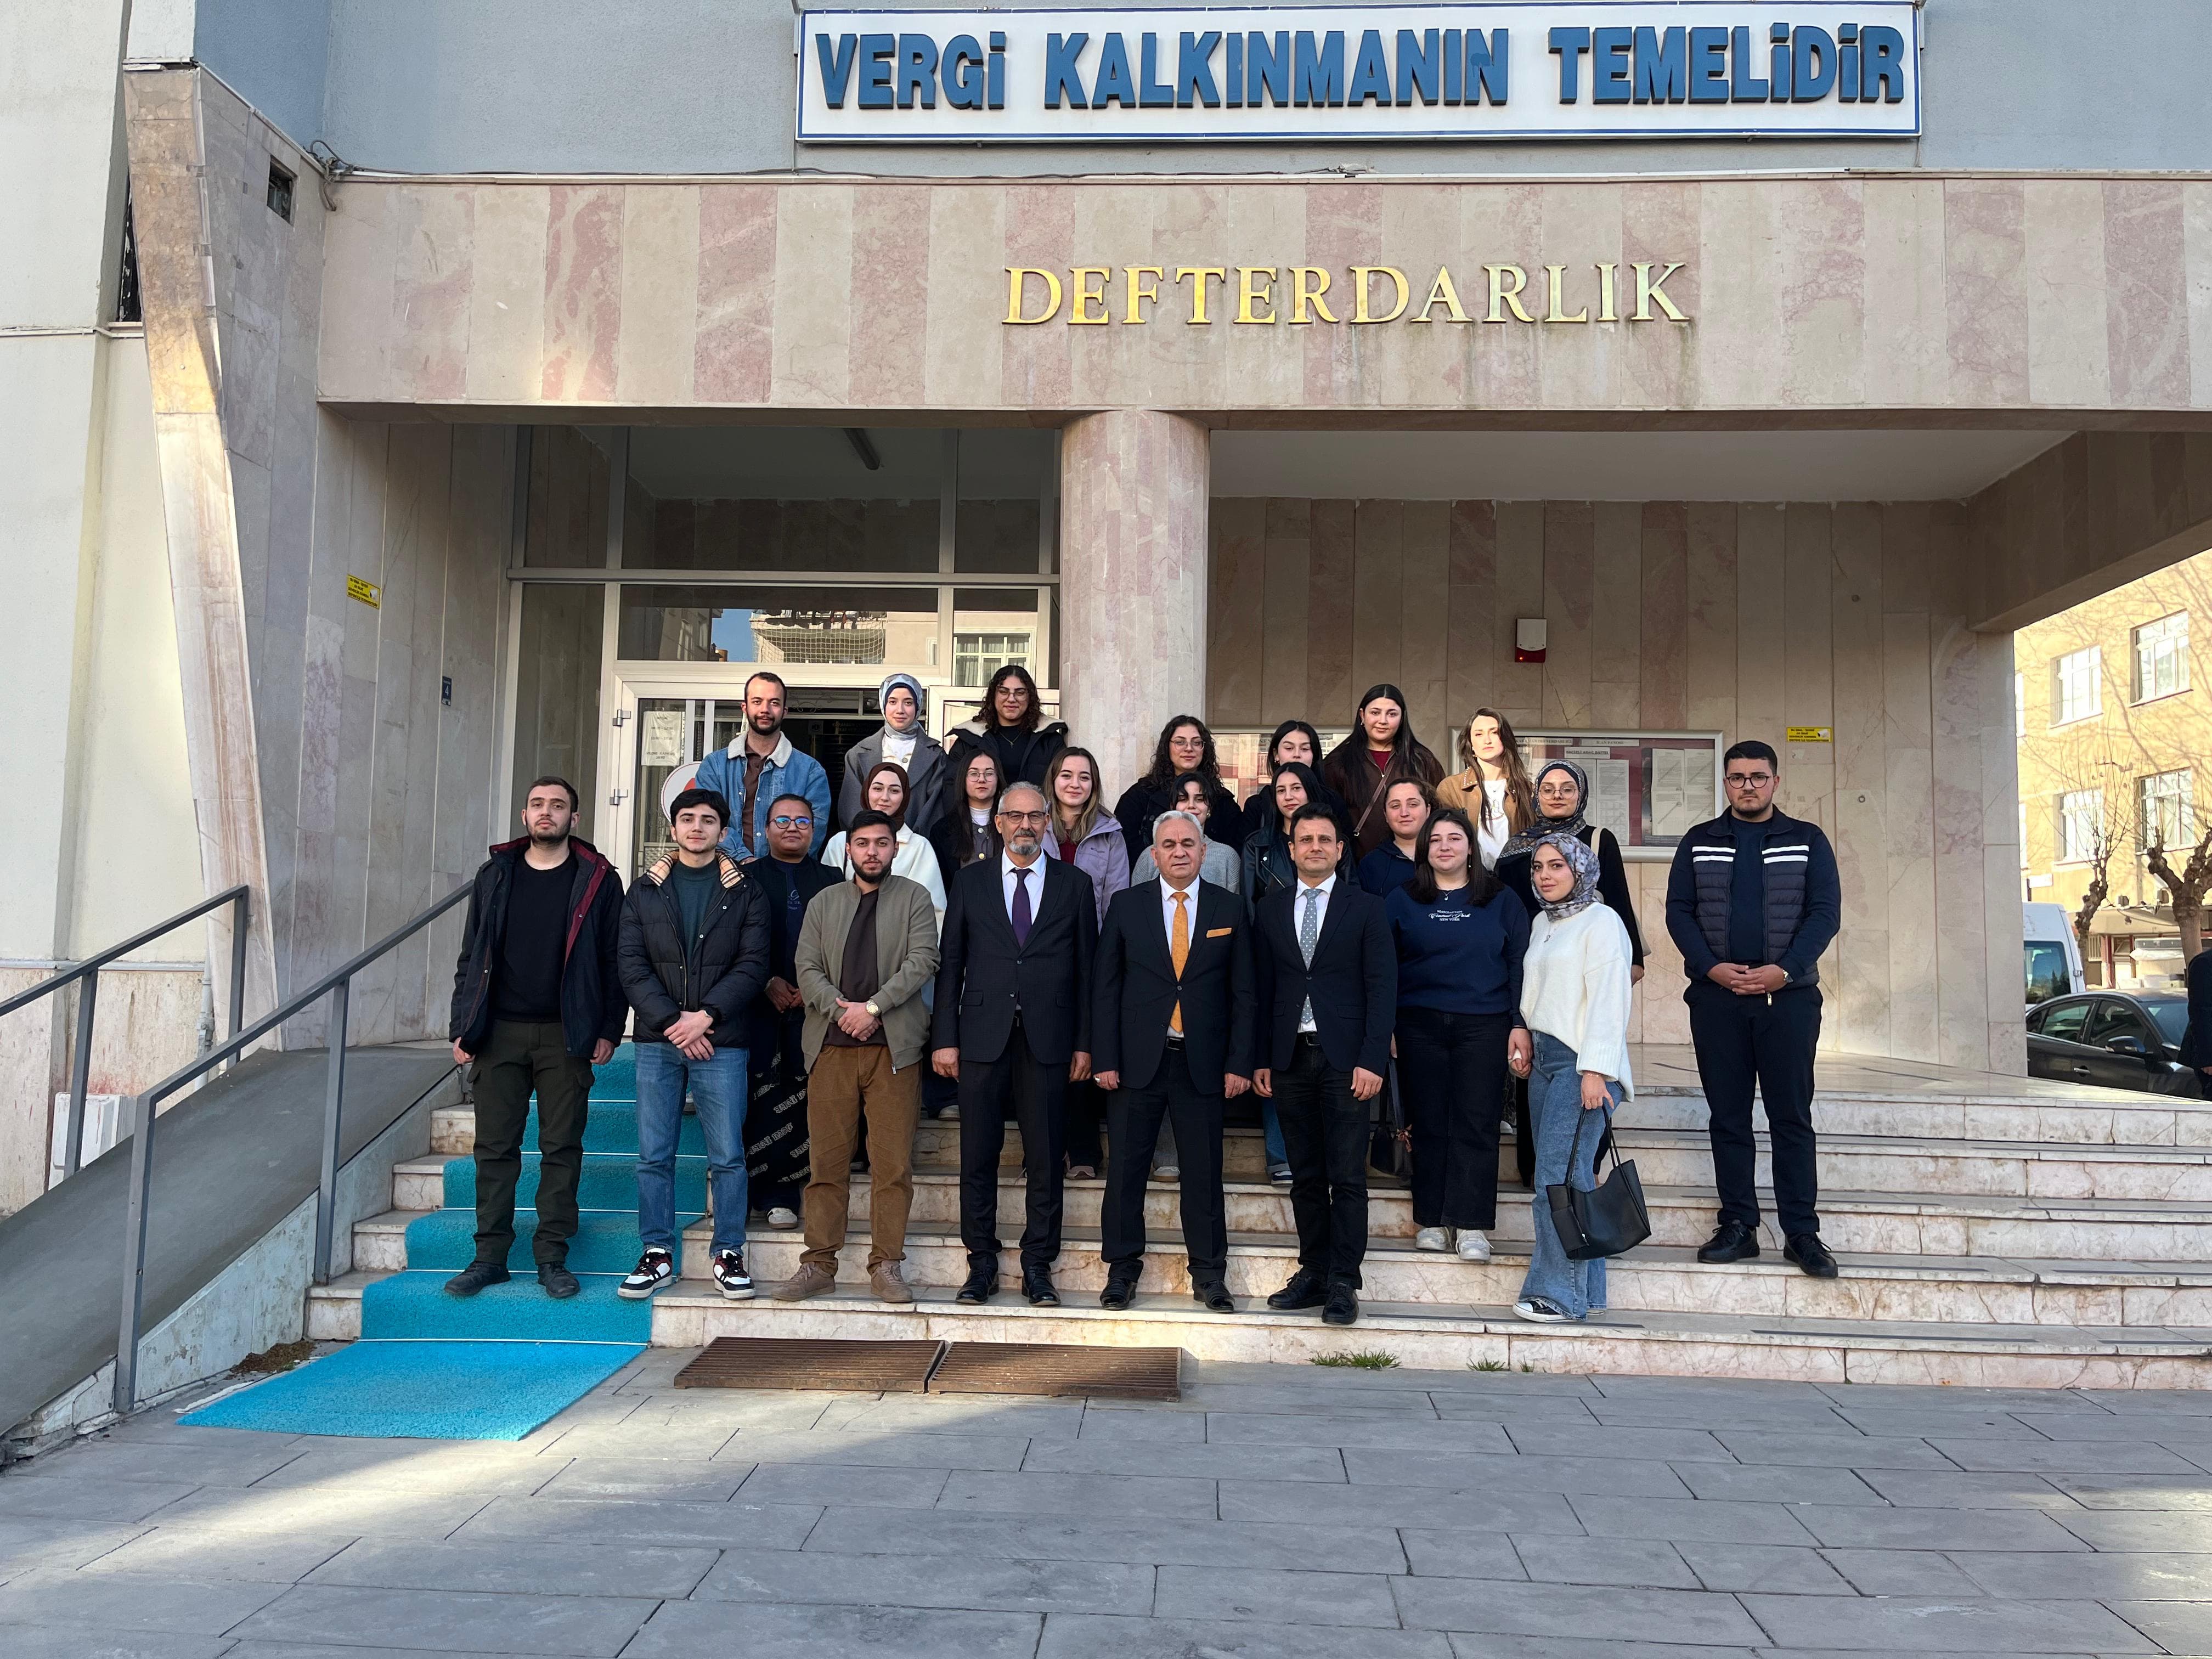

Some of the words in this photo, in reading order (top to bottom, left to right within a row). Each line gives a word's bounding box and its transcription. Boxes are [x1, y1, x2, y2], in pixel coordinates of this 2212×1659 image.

[815, 31, 1006, 109] VERGİ
[1044, 29, 1508, 109] KALKINMANIN
[1548, 22, 1904, 104] TEMELİDİR
[1002, 263, 1690, 325] DEFTERDARLIK
